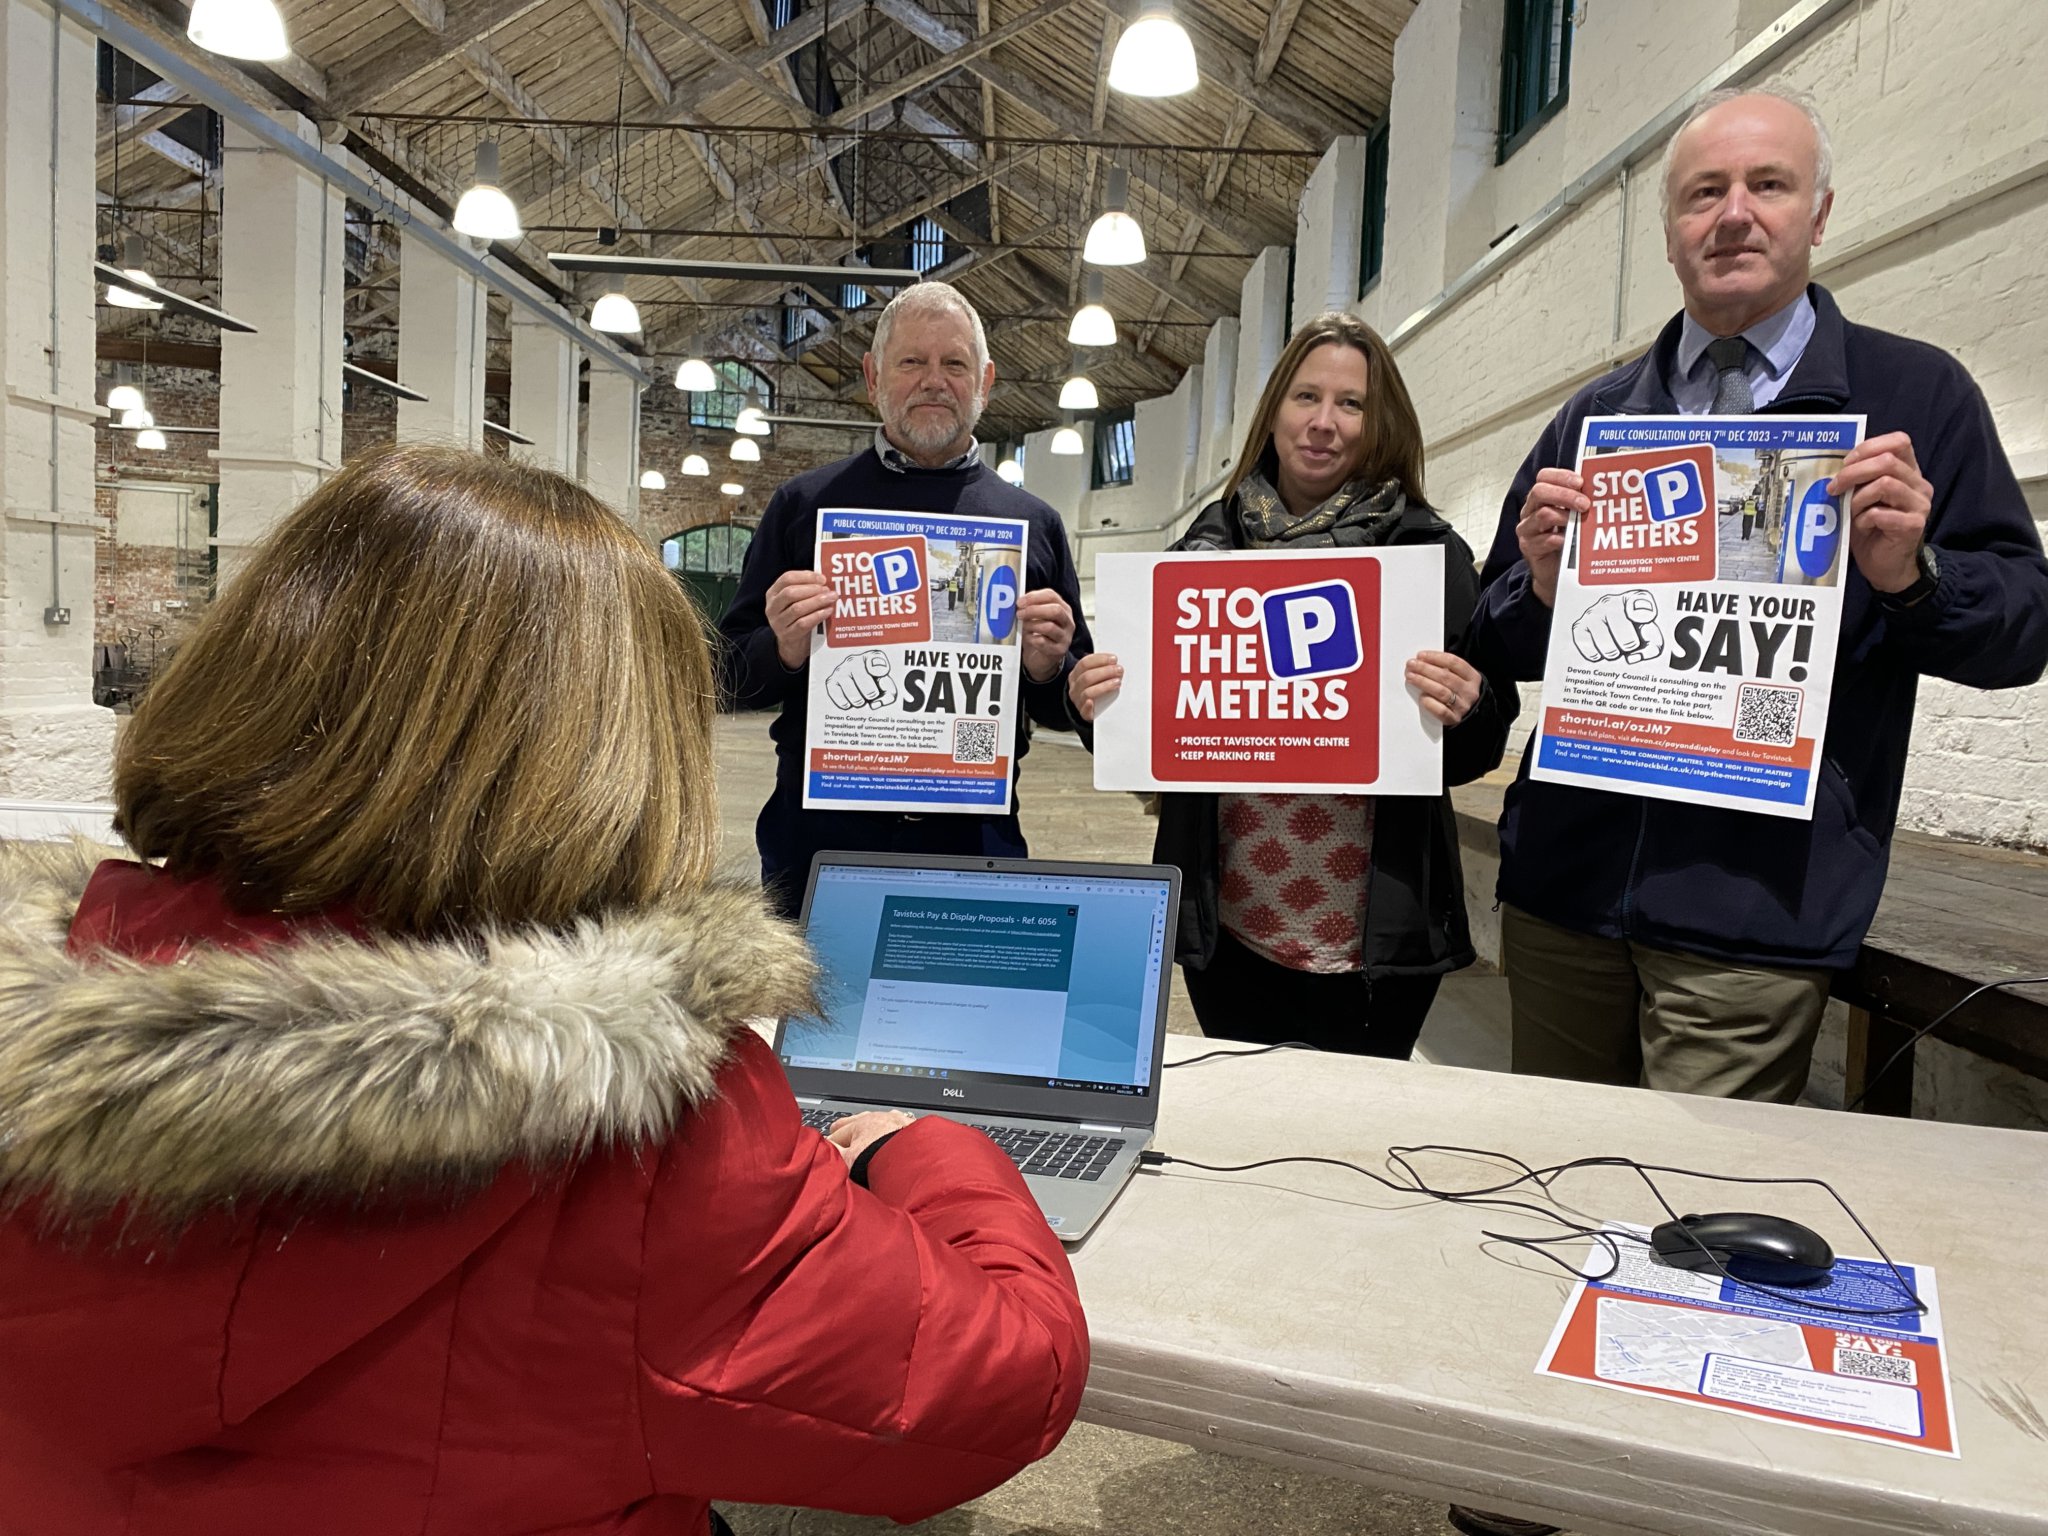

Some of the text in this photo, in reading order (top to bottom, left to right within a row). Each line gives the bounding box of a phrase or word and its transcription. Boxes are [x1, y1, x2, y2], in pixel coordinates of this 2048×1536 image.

[1599, 430, 1627, 440] PUBLIC
[1628, 430, 1687, 441] CONSULTATION
[1689, 430, 1712, 441] OPEN
[1728, 430, 1746, 441] DEC
[1748, 430, 1770, 442] 2023
[1796, 431, 1814, 442] JAN
[1816, 431, 1840, 442] 2024
[1593, 497, 1643, 524] THE
[833, 519, 855, 528] PUBLIC
[857, 520, 905, 531] CONSULTATION
[907, 523, 924, 533] OPEN
[936, 525, 948, 535] DEC
[950, 526, 966, 536] 2023
[984, 530, 996, 539] JAN
[997, 530, 1013, 540] 2024
[1593, 520, 1699, 550] METERS
[1800, 503, 1838, 552] P
[831, 575, 873, 596] THE
[835, 594, 917, 619] METERS
[989, 584, 1015, 620] P
[1677, 590, 1816, 621] HAVE YOUR
[904, 650, 1003, 671] HAVE YOUR
[1174, 634, 1258, 673] THE
[1669, 615, 1814, 683] SAY!
[1565, 676, 1604, 687] imposition
[1616, 683, 1656, 693] unwanted
[1658, 686, 1689, 698] parking
[1691, 690, 1723, 701] charges
[1567, 666, 1591, 675] Devon
[1593, 670, 1620, 680] County
[1622, 673, 1649, 682] Council
[1651, 675, 1657, 683] is
[1659, 677, 1699, 689] consulting
[1713, 681, 1726, 690] the
[903, 669, 1003, 716] SAY!
[1175, 679, 1349, 721] METERS
[1573, 687, 1608, 697] Tavistock
[1610, 691, 1631, 700] Town
[1632, 694, 1660, 703] Centre.
[1673, 699, 1691, 707] take
[1693, 702, 1712, 711] part,
[1581, 698, 1594, 706] the
[1595, 700, 1607, 708] QR
[1609, 702, 1628, 710] code
[1655, 707, 1668, 715] the
[1670, 709, 1684, 717] link
[1687, 710, 1714, 720] below.
[1560, 712, 1672, 735] shorturl.at/ozJM7
[1181, 736, 1350, 747] PROTECT TAVISTOCK TOWN CENTRE
[1181, 751, 1275, 761] KEEP PARKING FREE
[893, 909, 925, 919] Tavistock
[927, 911, 940, 922] Pay
[941, 912, 949, 920] &
[950, 912, 977, 923] Display
[978, 914, 1015, 925] Proposals
[1022, 916, 1036, 925] Ref.
[1037, 917, 1057, 926] 6056
[942, 1088, 965, 1098] DELL
